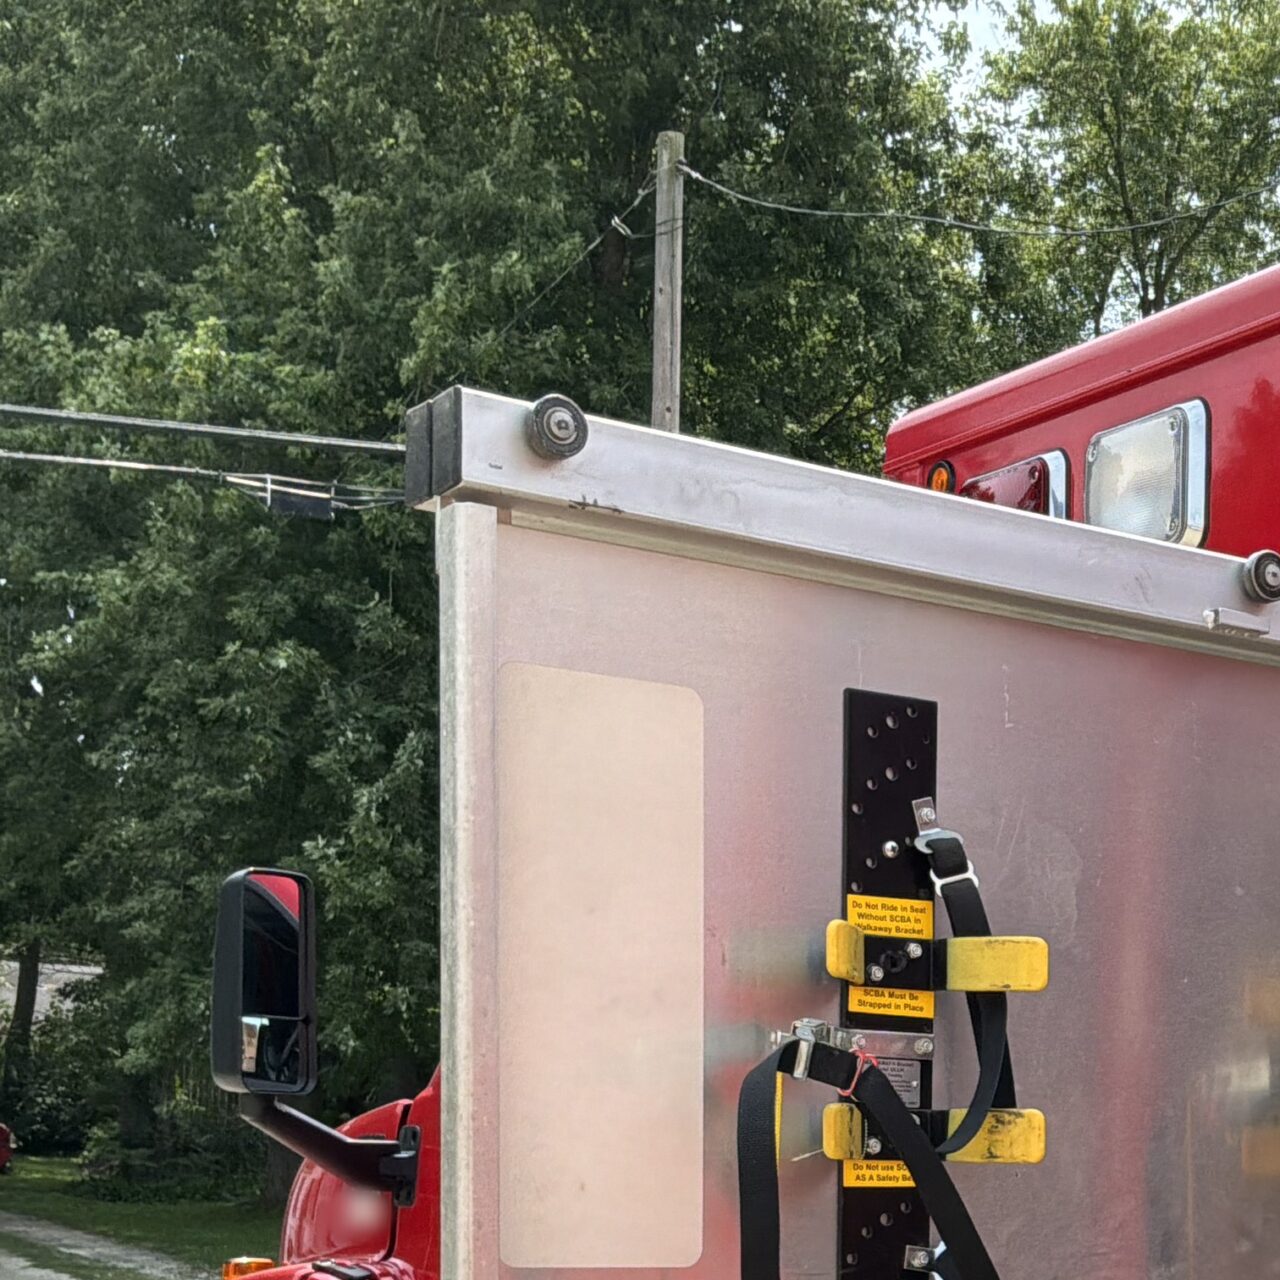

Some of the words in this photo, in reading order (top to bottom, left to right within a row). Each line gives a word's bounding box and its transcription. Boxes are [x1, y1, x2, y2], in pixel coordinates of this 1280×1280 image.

[851, 901, 863, 909] Do
[865, 902, 879, 910] Not
[881, 903, 899, 912] Ride
[909, 905, 926, 914] Seat
[857, 912, 888, 922] Without
[889, 915, 912, 923] SCBA
[895, 926, 925, 935] Bracket
[862, 989, 886, 998] SCBA
[888, 991, 907, 1000] Must
[908, 993, 919, 1001] Be
[857, 998, 892, 1010] Strapped
[903, 1003, 925, 1012] Place
[852, 1163, 864, 1171] Do
[865, 1163, 880, 1171] Not
[896, 1163, 908, 1171] SC
[855, 1174, 866, 1182] AS
[868, 1174, 875, 1182] A
[876, 1175, 900, 1183] Safety
